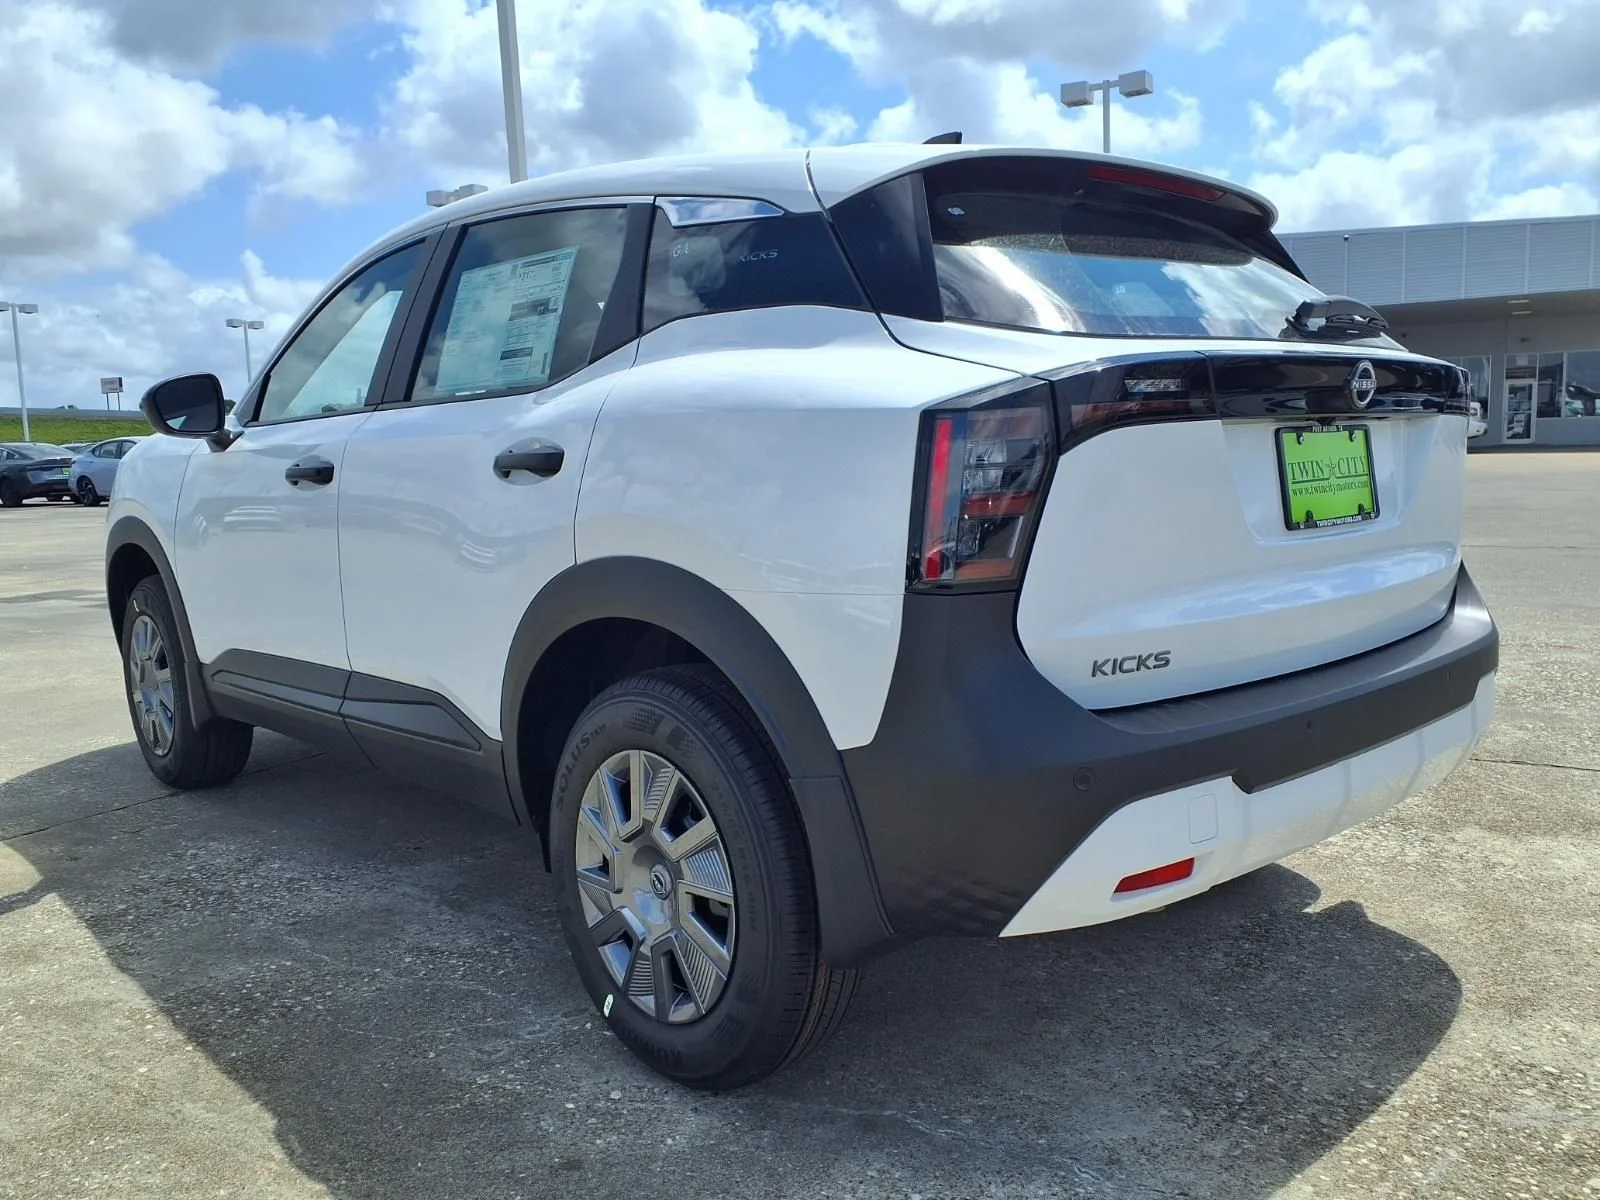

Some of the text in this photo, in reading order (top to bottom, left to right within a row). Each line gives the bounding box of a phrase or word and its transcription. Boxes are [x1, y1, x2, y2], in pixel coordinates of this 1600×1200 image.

[1287, 455, 1366, 480] TWIN CITY
[1291, 480, 1369, 496] www.twincitymotors.com
[1091, 649, 1171, 678] KICKS
[556, 731, 591, 812] SOLUS
